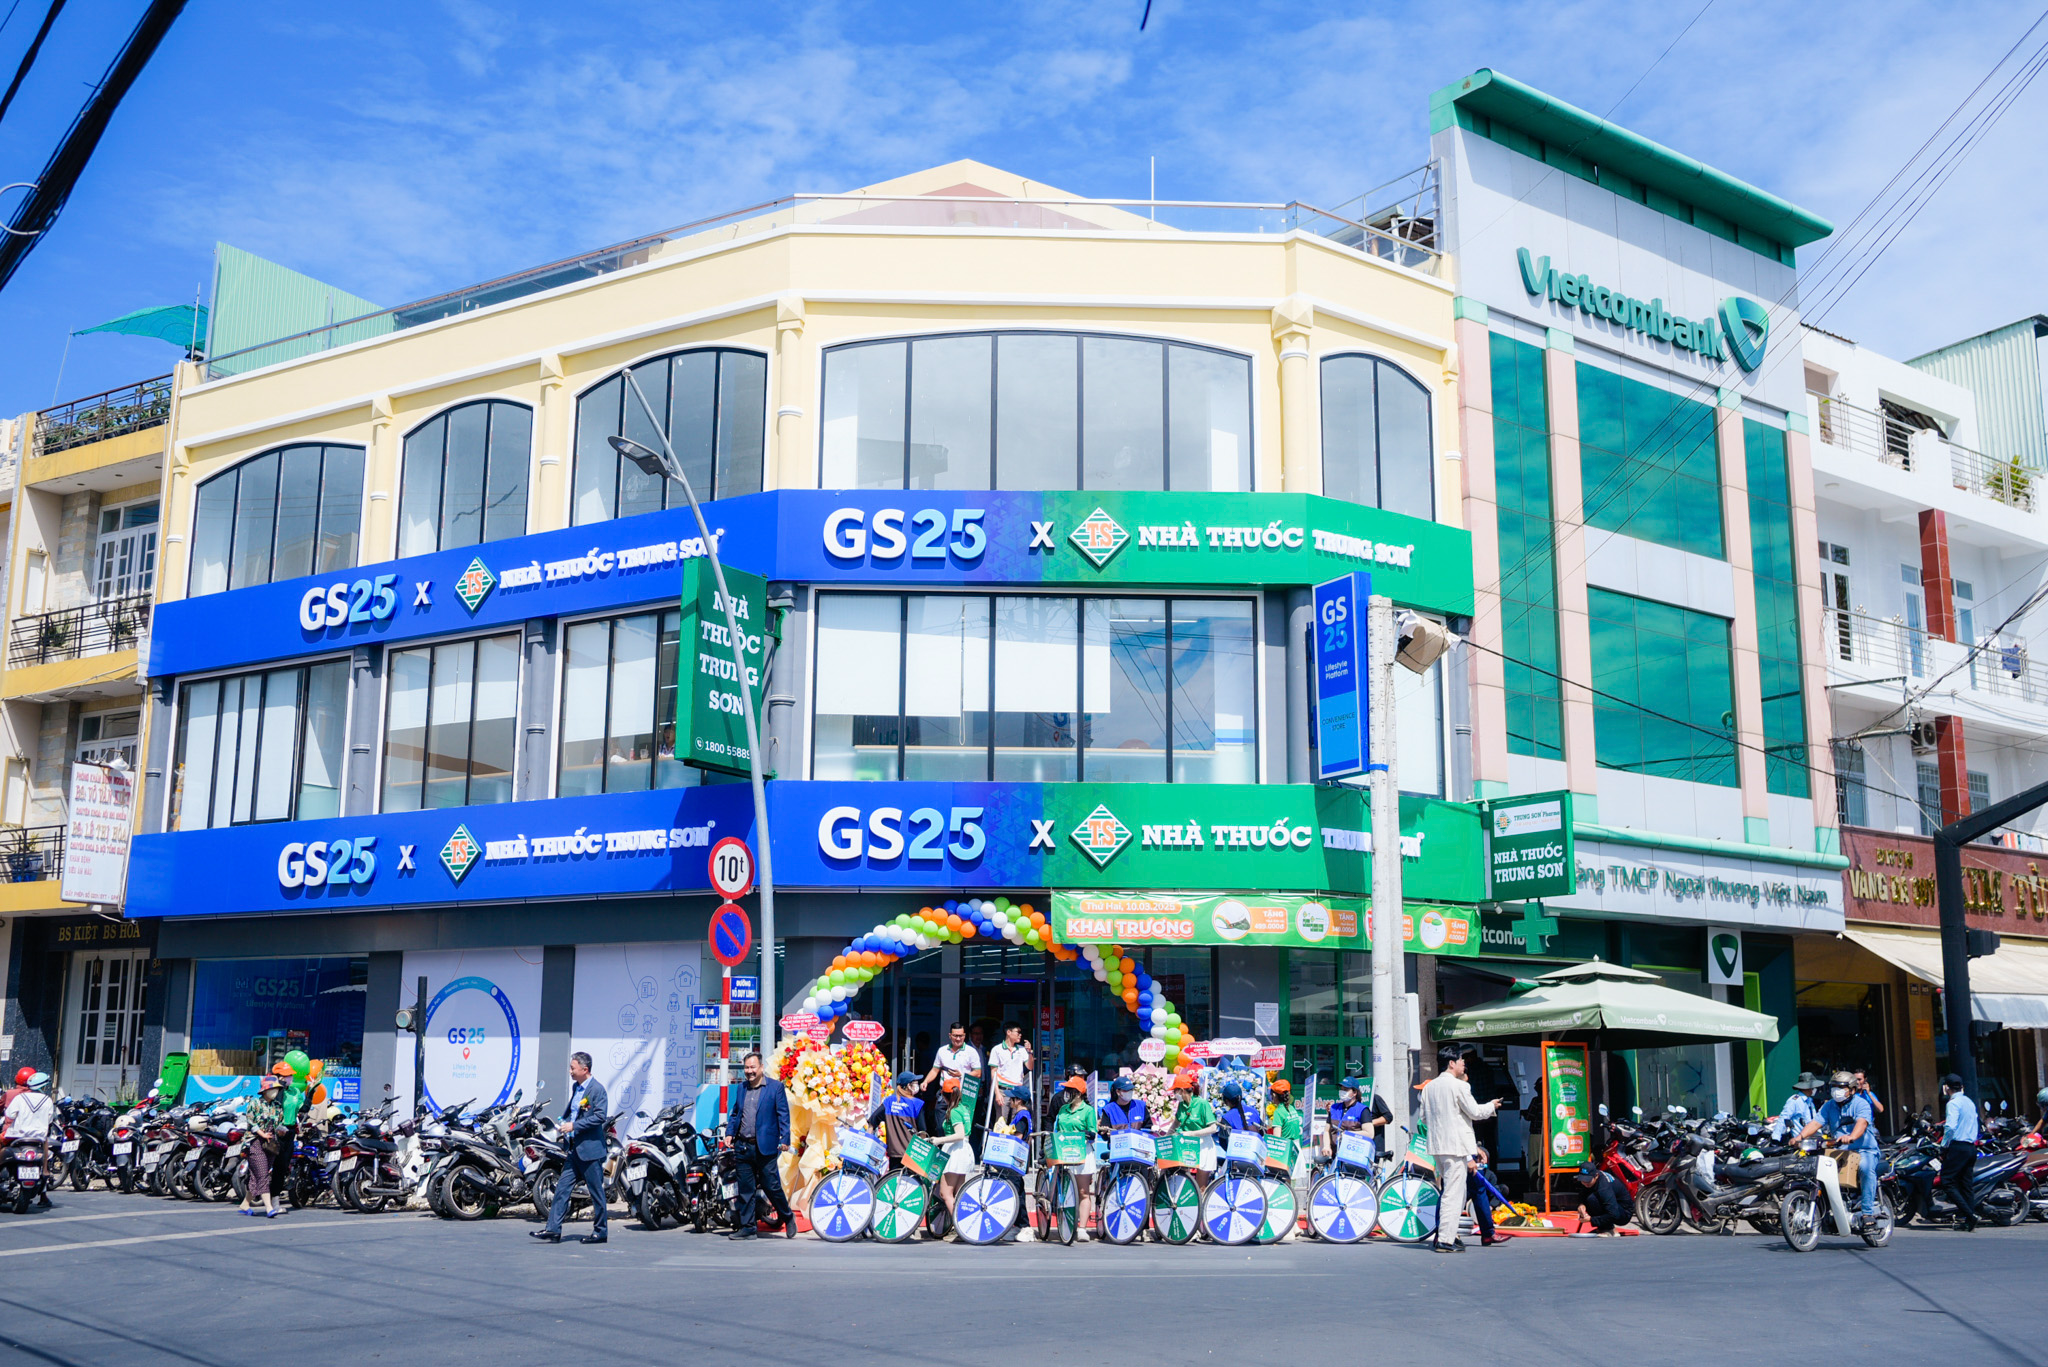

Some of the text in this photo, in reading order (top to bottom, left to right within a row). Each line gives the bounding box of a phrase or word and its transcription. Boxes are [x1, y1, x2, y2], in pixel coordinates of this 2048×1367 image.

[1516, 246, 1729, 364] Vietcombank
[822, 506, 988, 560] GS25
[1087, 522, 1114, 548] TS
[1138, 521, 1200, 547] NHÀ
[1206, 519, 1305, 549] THUỐC
[1312, 529, 1374, 560] TRUNG
[300, 574, 399, 632] GS25
[466, 571, 484, 595] TS
[499, 560, 543, 589] NHÀ
[544, 547, 615, 581] THUỐC
[617, 541, 679, 570] TRUNG
[713, 590, 749, 620] NHÀ
[1324, 659, 1348, 673] Lifestyle
[1325, 668, 1349, 680] Platform
[1322, 711, 1356, 726] CONVENIENCE
[1332, 722, 1346, 732] STORE
[704, 740, 725, 754] 1800
[818, 806, 987, 861] GS25
[1088, 819, 1117, 847] TS
[1142, 819, 1205, 847] NHÀ
[1211, 817, 1313, 848] THUỐC
[278, 836, 377, 889] GS25
[450, 840, 469, 864] TS
[484, 834, 529, 860] NHÀ
[531, 826, 603, 858] THUỐC
[605, 829, 668, 853] TRUNG
[1494, 841, 1563, 865] NHÀ THUỐC
[1494, 867, 1535, 884] TRUNG
[1849, 863, 1888, 901] VÀNG
[1890, 870, 1910, 905] ĐÁ
[1608, 864, 1660, 890] TMCP
[1762, 880, 1792, 909] Việt
[1795, 884, 1829, 905] Nam
[1086, 900, 1104, 911] Thứ
[1126, 901, 1176, 911] 10.03.2025
[1263, 909, 1284, 919] TẶNG
[1068, 917, 1193, 936] KHAI TRƯƠNG
[1338, 913, 1355, 923] TẶNG
[58, 927, 72, 942] BS
[74, 922, 99, 944] KIỆT
[102, 924, 117, 940] BS
[254, 977, 300, 998] GS25
[1443, 1026, 1477, 1036] Vietcombank
[1537, 1018, 1573, 1028] Vietcombank
[1620, 1015, 1659, 1026] Vietcombank
[1719, 1024, 1756, 1034] Vietcombank
[447, 1027, 486, 1045] GS25
[452, 1063, 477, 1072] Lifestyle
[452, 1071, 477, 1079] Platform
